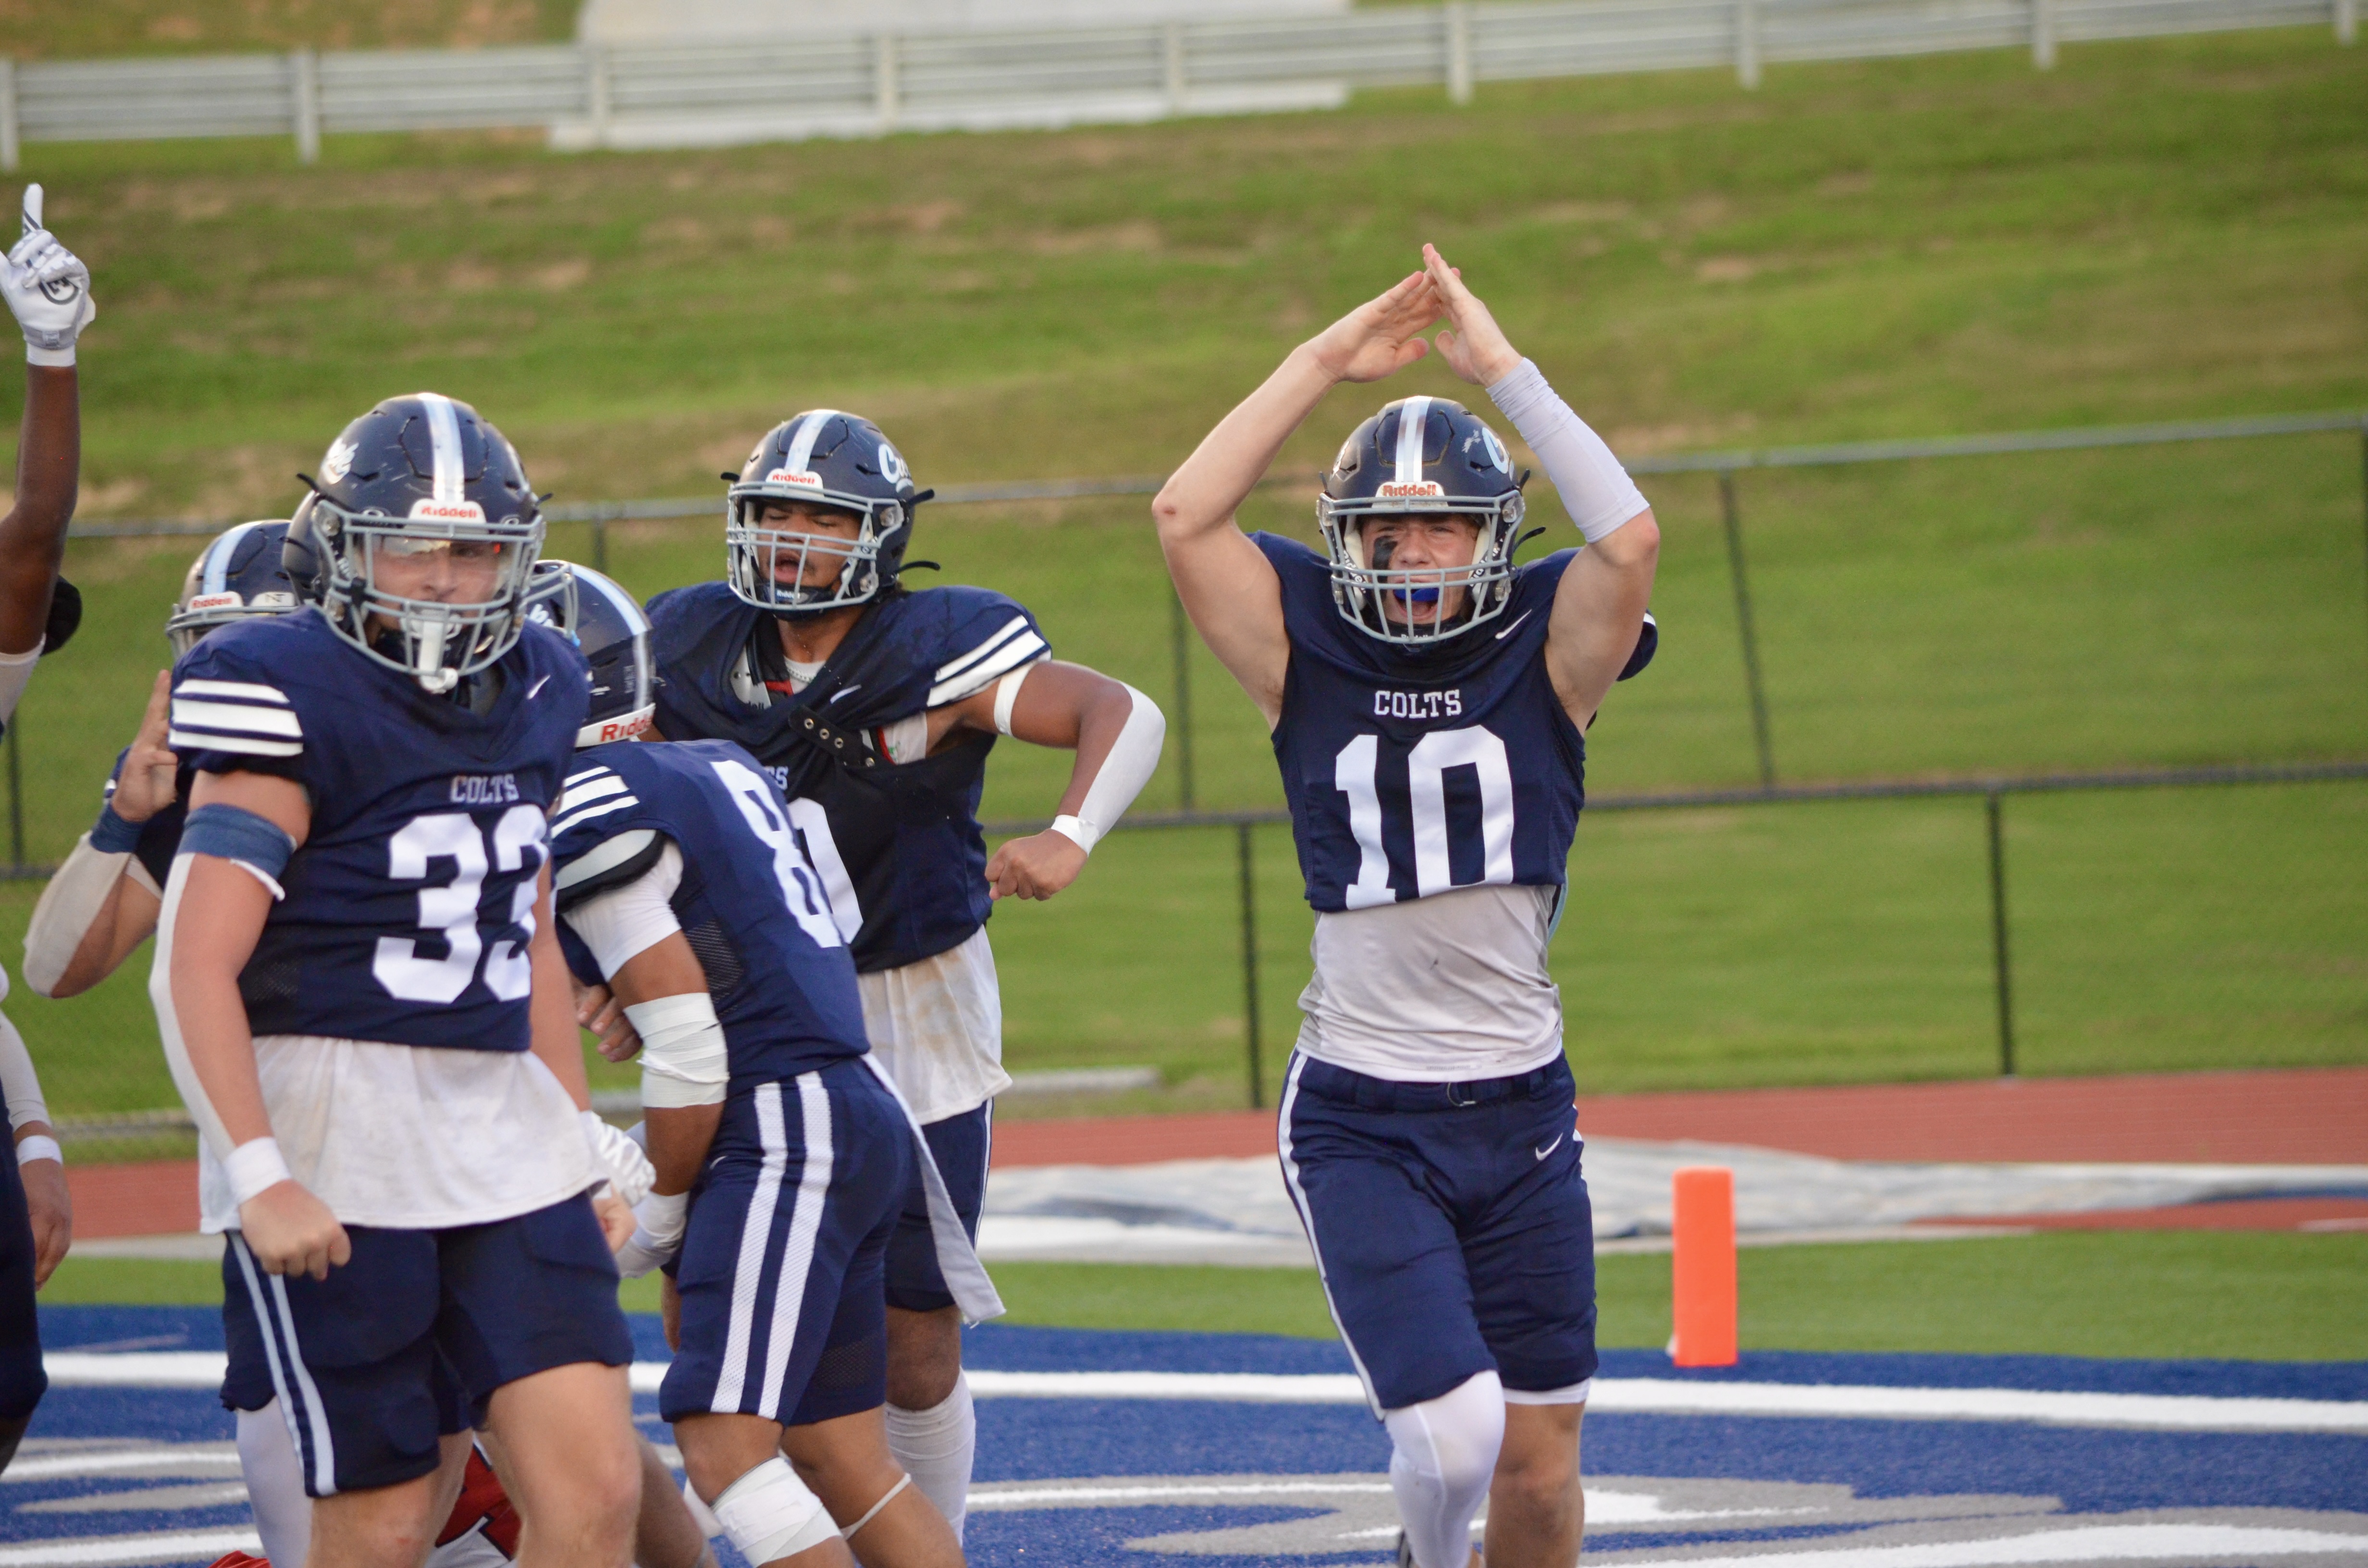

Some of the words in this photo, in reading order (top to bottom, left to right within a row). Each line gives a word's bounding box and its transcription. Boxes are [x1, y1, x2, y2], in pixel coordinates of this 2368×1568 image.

[772, 474, 815, 484] Riddell
[1383, 484, 1437, 496] Riddell
[421, 506, 477, 518] Riddell
[1374, 689, 1462, 719] COLTS
[450, 773, 519, 804] COLTS
[1335, 724, 1514, 910] 10
[372, 803, 549, 1004] 33
